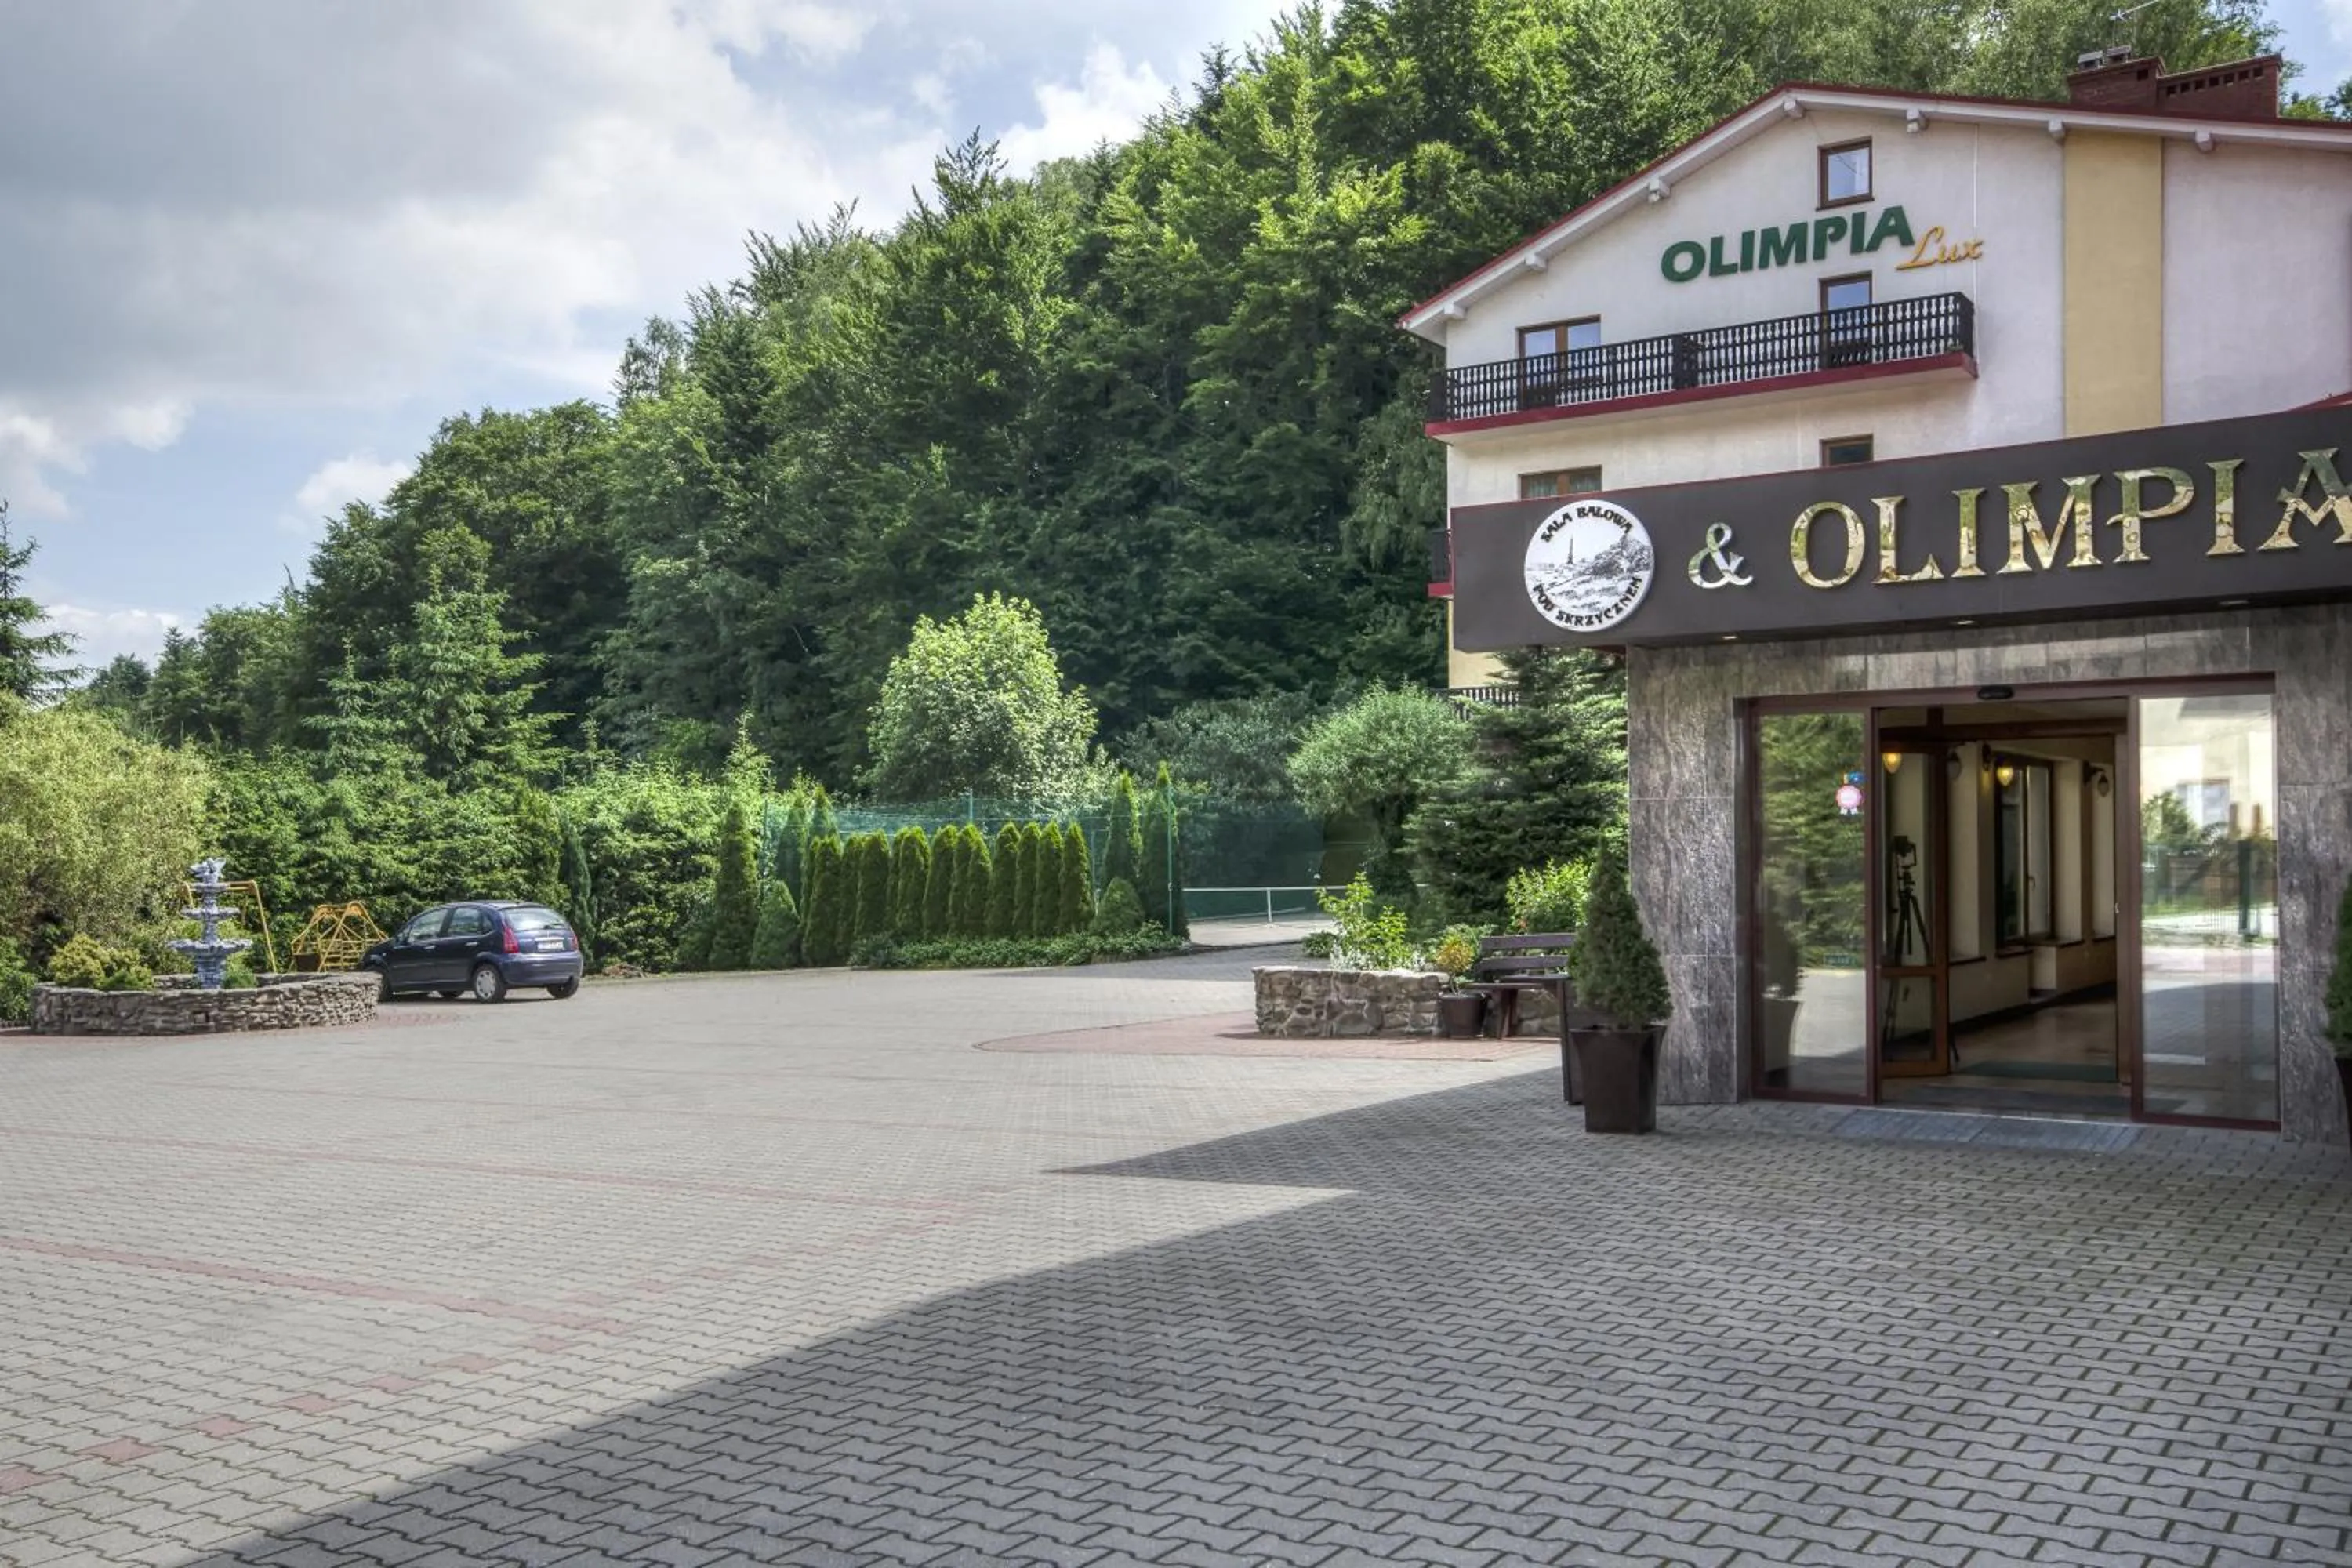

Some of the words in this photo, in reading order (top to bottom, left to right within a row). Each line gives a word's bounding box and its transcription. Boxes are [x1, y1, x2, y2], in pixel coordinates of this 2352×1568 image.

[1661, 205, 1915, 283] OLIMPIA
[1895, 226, 1984, 271] Lux
[1541, 512, 1573, 543] SALA
[1575, 506, 1633, 534] BALOWA
[1688, 522, 1754, 589] &
[1790, 448, 2352, 590] OLIMPIA
[1533, 583, 1555, 612] POD
[1555, 576, 1642, 626] SKRZYCZNEM
